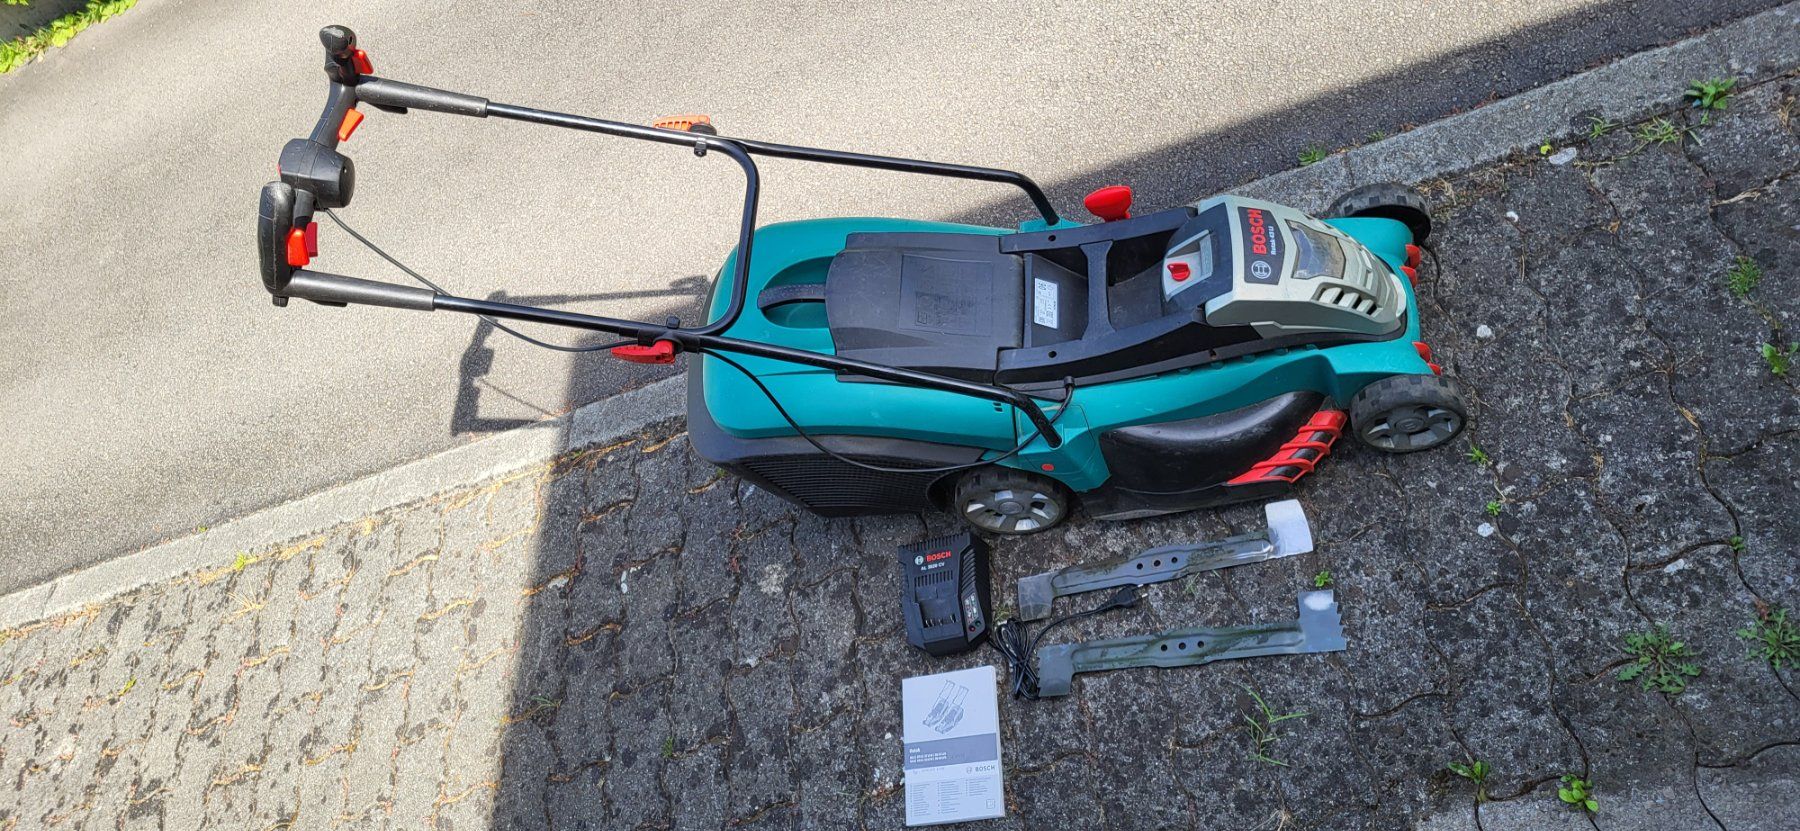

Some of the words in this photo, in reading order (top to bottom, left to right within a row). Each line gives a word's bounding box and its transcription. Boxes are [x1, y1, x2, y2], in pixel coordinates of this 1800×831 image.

[1247, 209, 1267, 255] BOSCH
[926, 550, 952, 562] BOSCH
[975, 765, 996, 773] BOSCH
